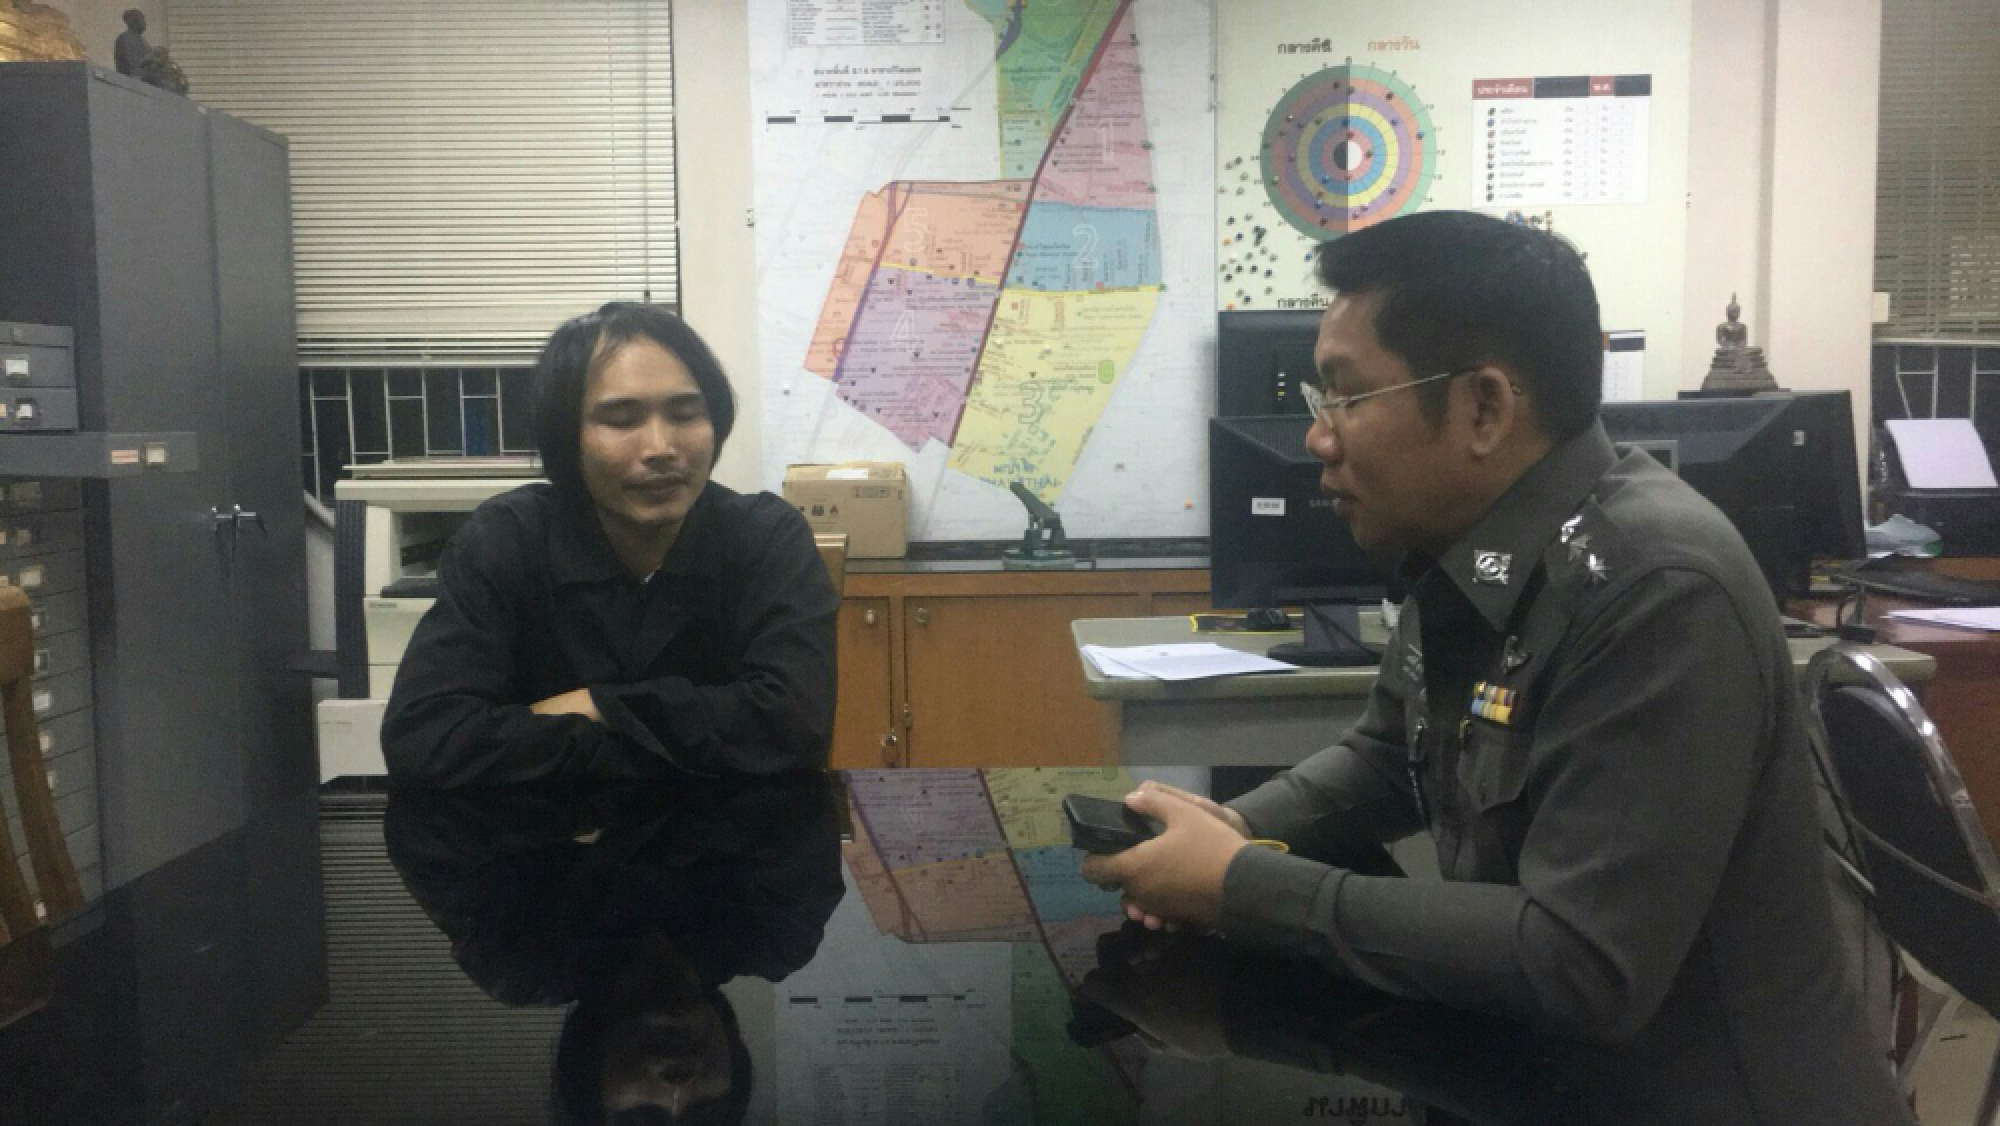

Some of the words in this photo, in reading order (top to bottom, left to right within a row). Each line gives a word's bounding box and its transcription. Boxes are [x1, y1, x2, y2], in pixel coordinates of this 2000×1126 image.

[1368, 36, 1420, 51] กลางวัน
[904, 207, 928, 252] 5
[1072, 224, 1099, 269] 2
[889, 310, 919, 350] 4
[1018, 380, 1045, 425] 3
